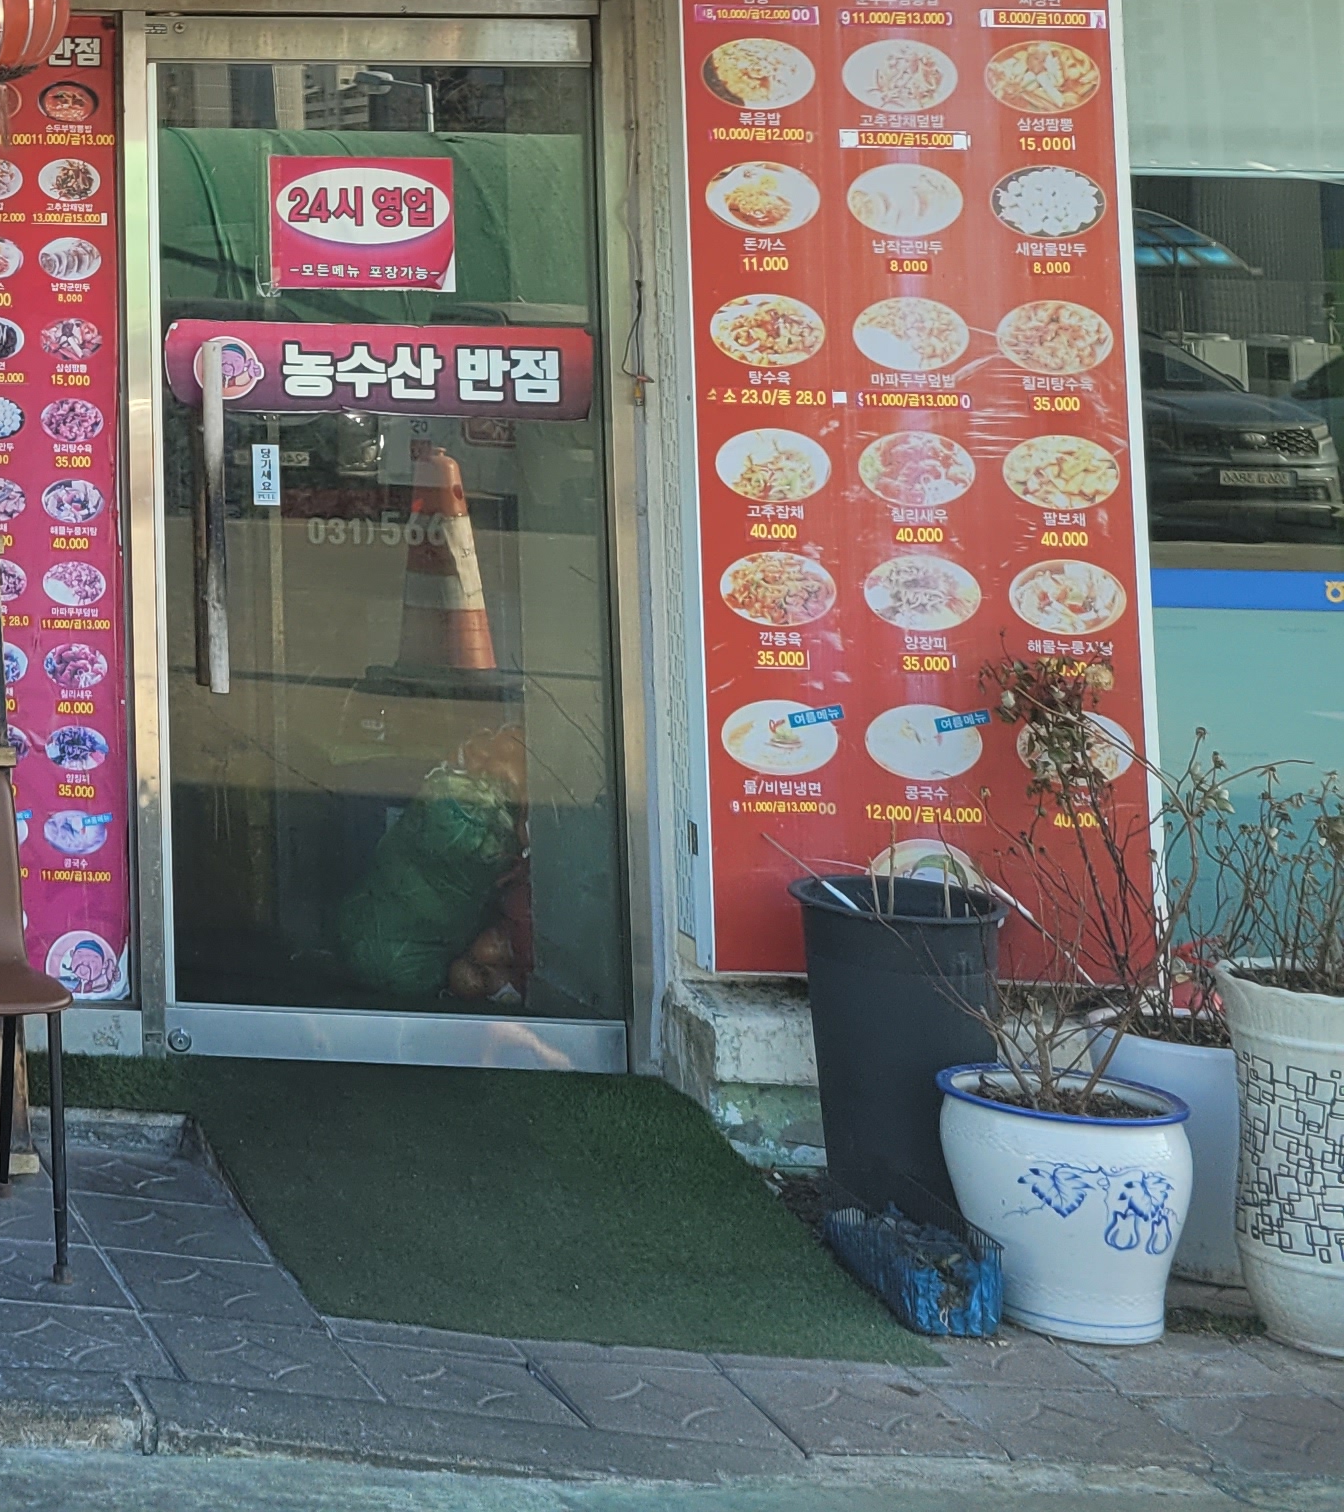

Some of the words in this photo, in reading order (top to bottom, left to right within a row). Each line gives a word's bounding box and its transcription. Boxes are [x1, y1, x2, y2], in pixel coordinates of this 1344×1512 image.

[739, 112, 781, 126] 볶음밥
[288, 186, 364, 226] 24시
[372, 186, 435, 227] 영업
[743, 237, 787, 252] 돈까스
[742, 256, 789, 271] 11.000
[889, 260, 928, 272] 8.000
[1033, 261, 1071, 274] 8.000
[51, 374, 90, 386] 15.000
[282, 342, 443, 399] 농수산
[456, 346, 561, 403] 반점
[749, 371, 791, 385] 탕수육
[1033, 396, 1080, 412] 35.000
[55, 456, 91, 468] 35.000
[747, 505, 804, 520] 고추잡채
[1042, 512, 1086, 527] 팔보채
[750, 524, 797, 539] 40.000
[896, 527, 944, 543] 40.000
[1040, 531, 1088, 547] 40.000
[52, 538, 89, 550] 40.000
[759, 632, 802, 647] 깐풍육
[757, 651, 805, 667] 35.000
[902, 656, 950, 672] 35.000
[57, 702, 94, 714] 40.000
[58, 785, 94, 798] 35.000
